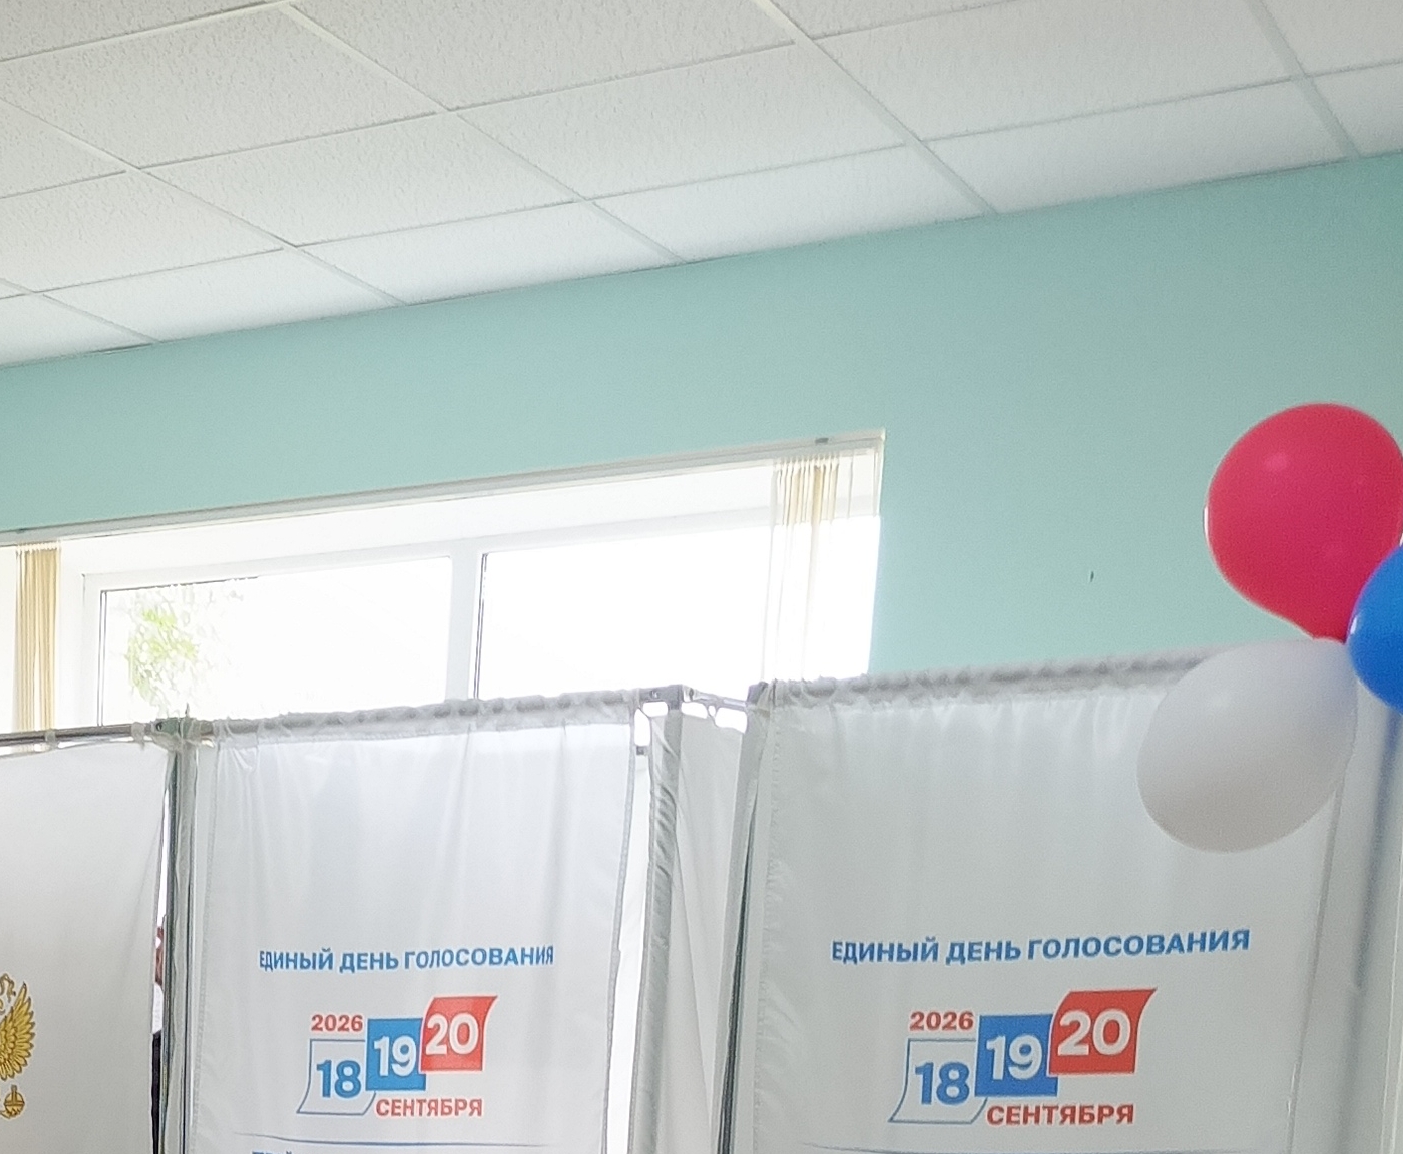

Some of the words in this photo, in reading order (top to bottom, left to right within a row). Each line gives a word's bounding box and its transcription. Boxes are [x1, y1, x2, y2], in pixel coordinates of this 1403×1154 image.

[832, 937, 938, 964] ЕДИНЫЙ
[945, 940, 1021, 965] ДЕНЬ
[1027, 929, 1250, 961] ГОЛОСОВАНИЯ
[259, 948, 333, 972] ЕДИНЫЙ
[339, 951, 399, 973] ДЕНЬ
[404, 946, 554, 970] ГОЛОСОВАНИЯ
[310, 1014, 363, 1032] 2026
[910, 1011, 974, 1031] 2026
[316, 1060, 361, 1099] 18
[373, 1036, 417, 1077] 19
[425, 1012, 479, 1055] 20
[915, 1062, 970, 1105] 18
[985, 1035, 1042, 1081] 19
[1057, 1008, 1131, 1056] 20
[375, 1099, 483, 1116] СЕНТЯБРЯ
[987, 1104, 1133, 1126] СЕНТЯБРЯ
